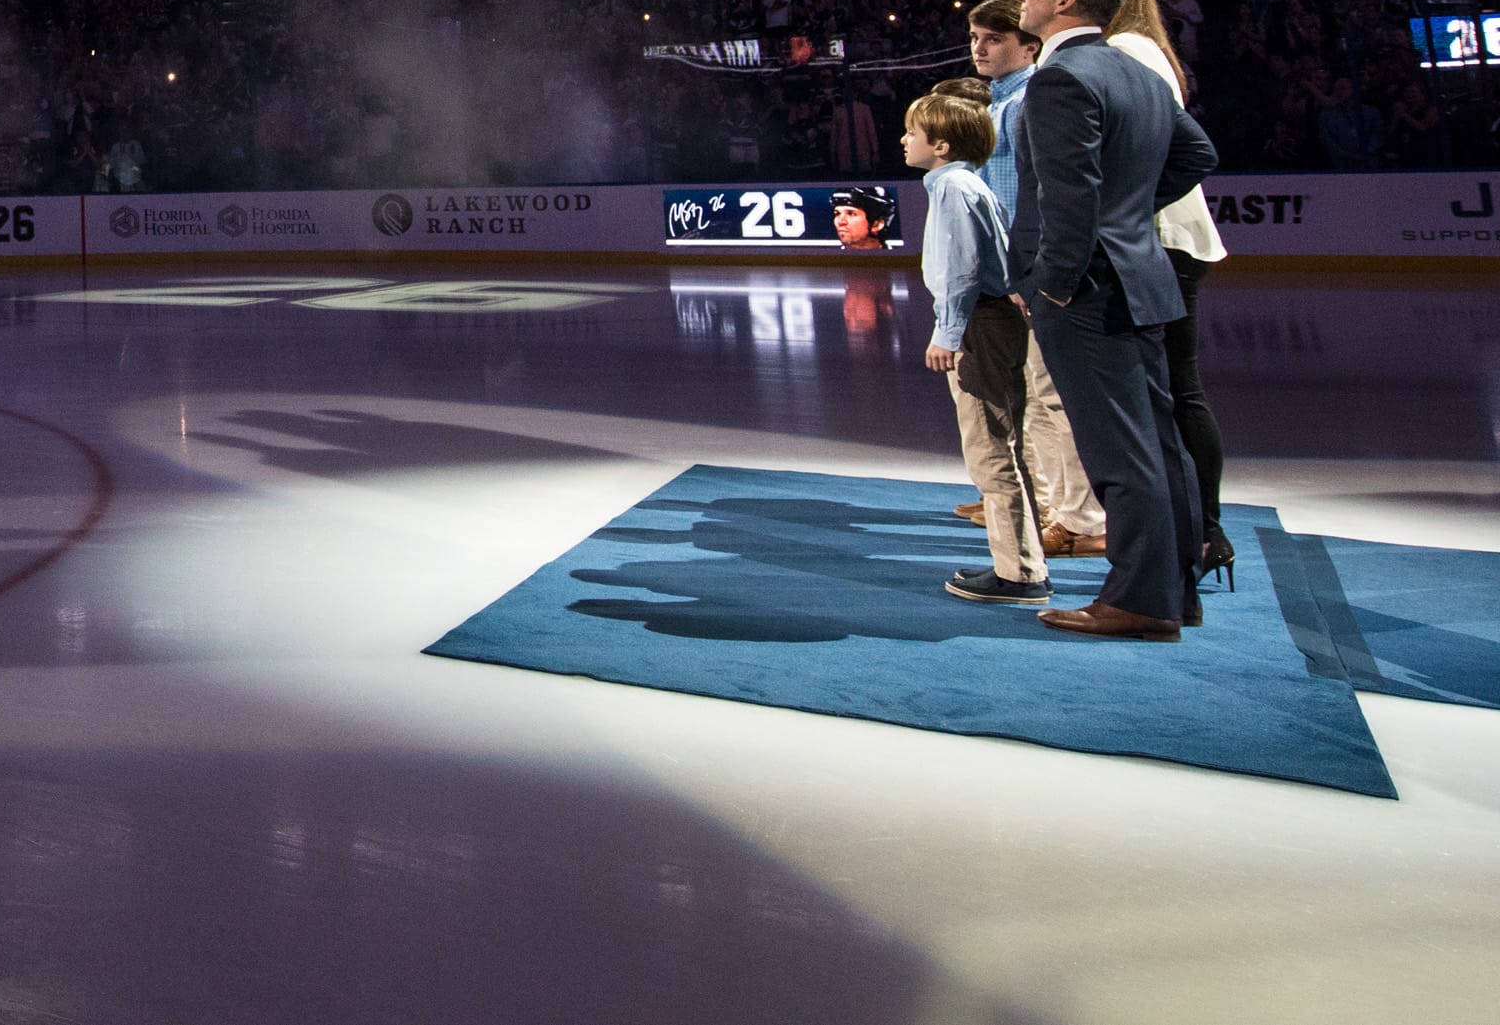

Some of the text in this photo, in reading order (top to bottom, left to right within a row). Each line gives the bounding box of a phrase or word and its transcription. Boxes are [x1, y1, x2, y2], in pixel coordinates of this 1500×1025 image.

[426, 194, 592, 212] LAKEWOOD
[144, 208, 202, 222] FLORIDA
[252, 207, 311, 221] FLORIDA
[739, 191, 805, 238] 26
[144, 223, 211, 236] HOSPITAL
[252, 222, 320, 235] HOSPITAL
[426, 218, 526, 234] RANCH
